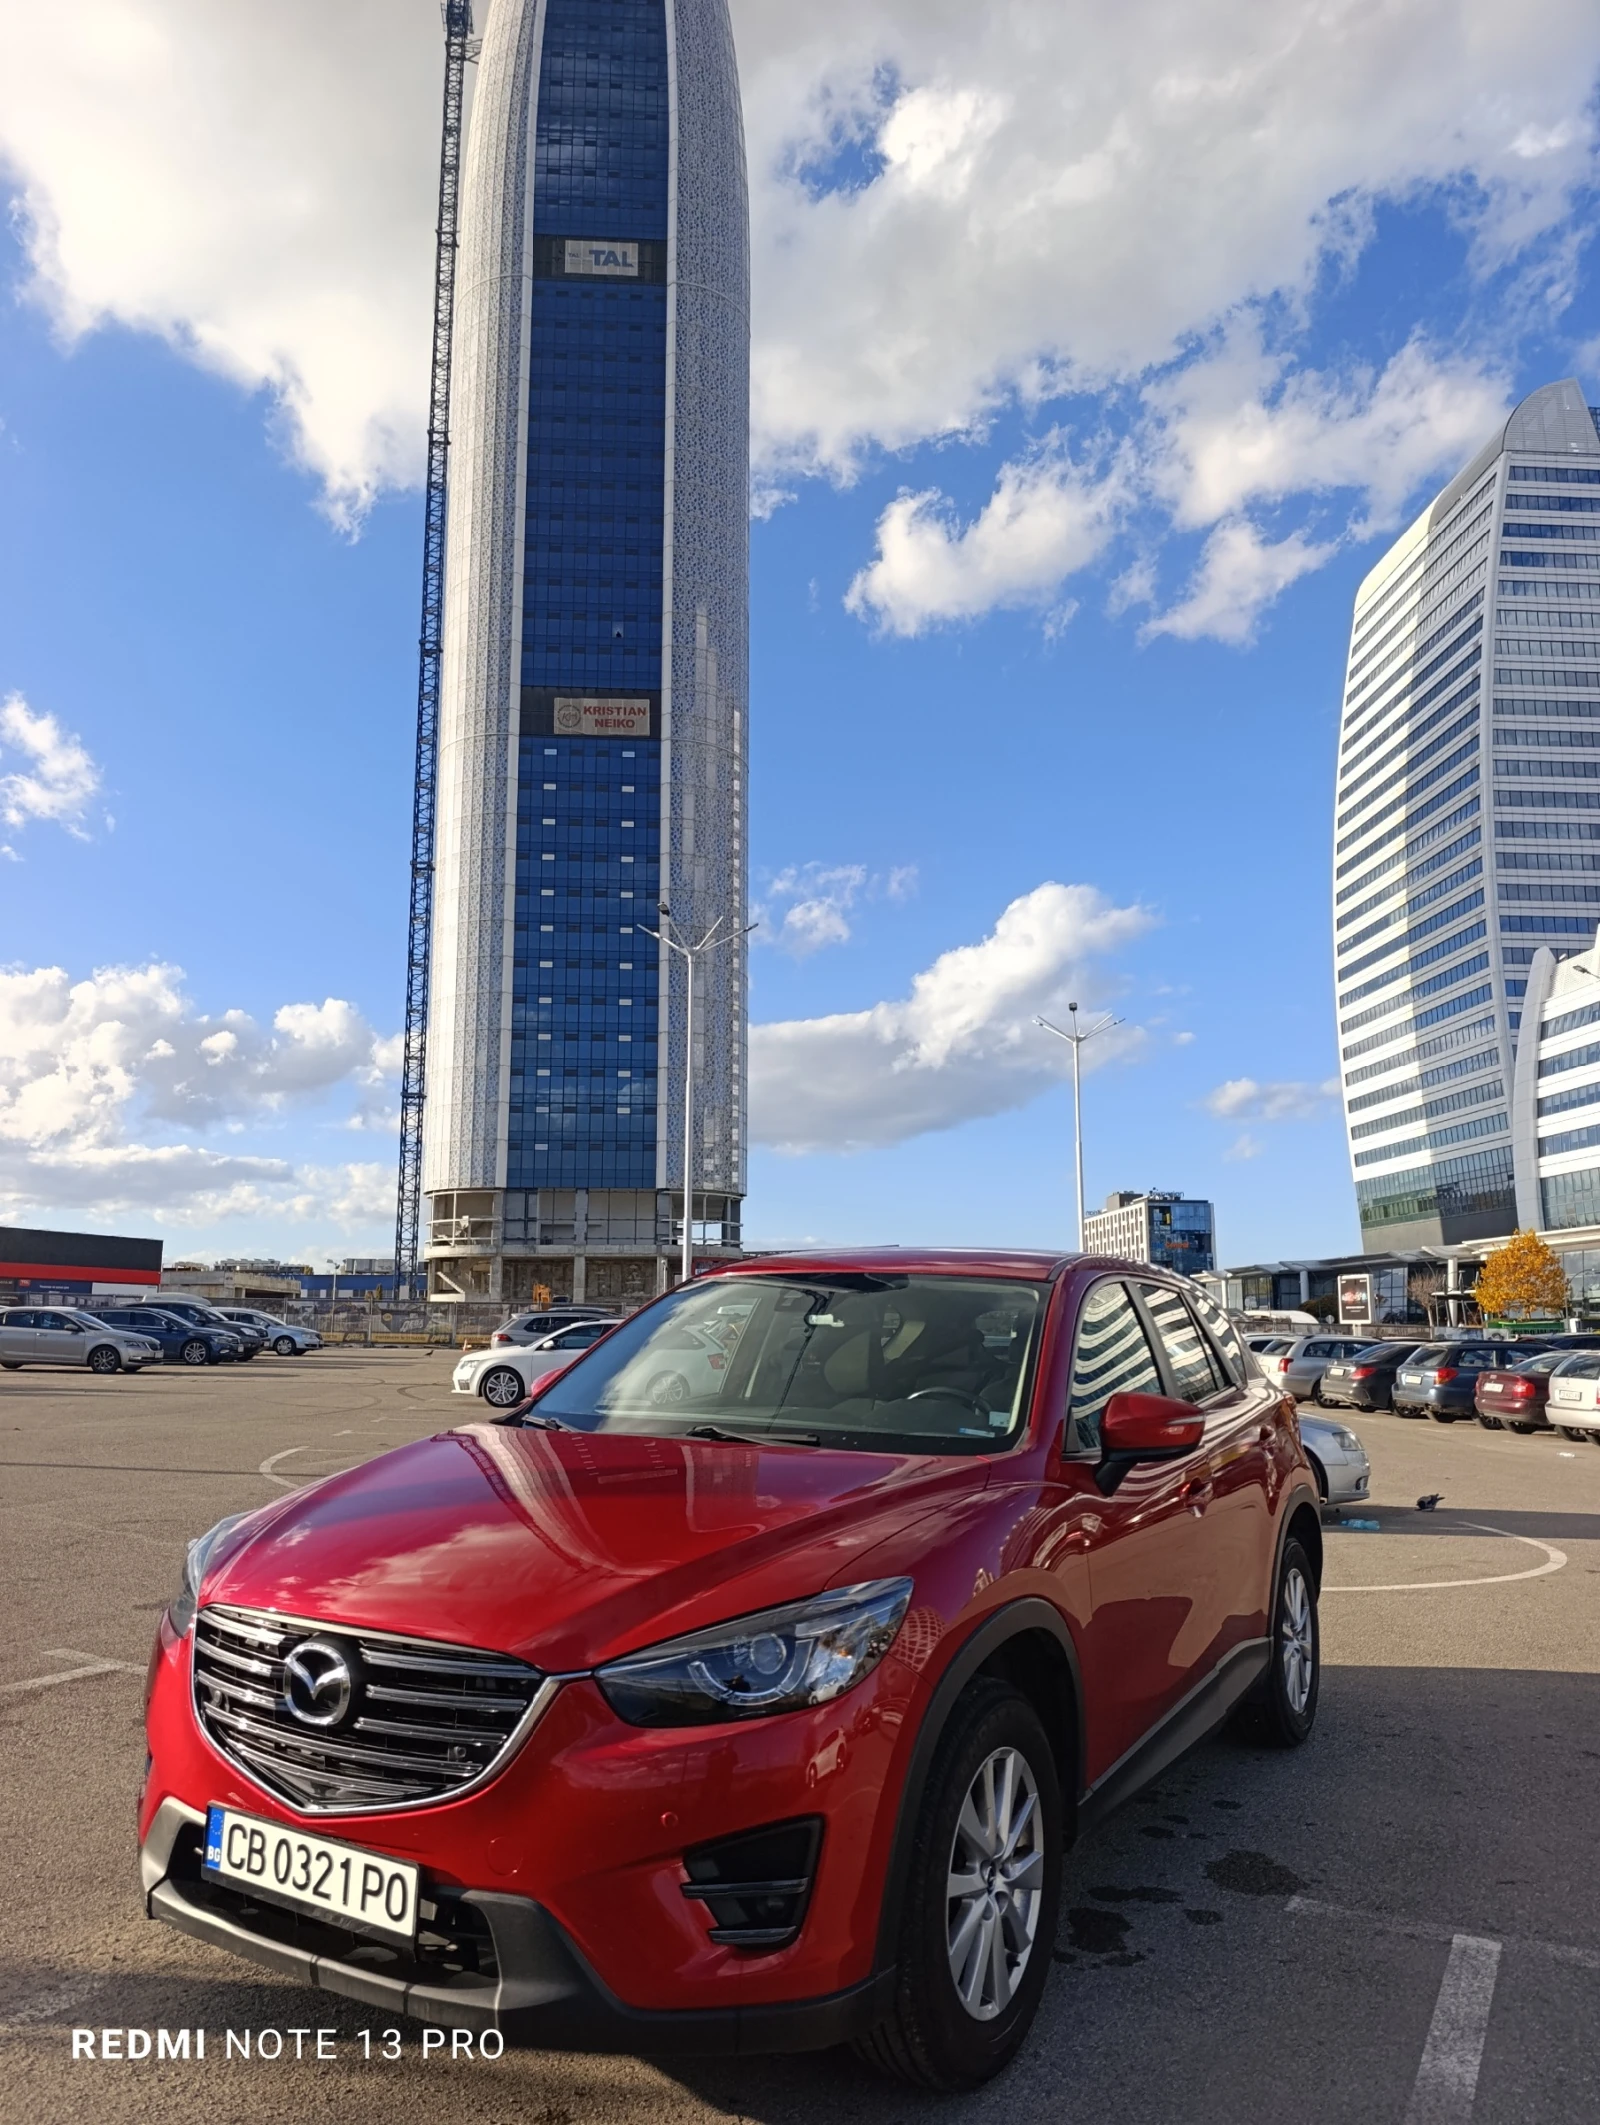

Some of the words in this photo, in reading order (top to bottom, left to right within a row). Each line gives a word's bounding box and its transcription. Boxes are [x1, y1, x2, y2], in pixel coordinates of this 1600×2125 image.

[589, 249, 634, 268] TAL
[583, 706, 647, 716] KRISTIAN
[594, 719, 636, 728] NEIKO
[207, 1845, 221, 1861] BG
[227, 1823, 267, 1876] CB
[273, 1838, 352, 1907] 0321
